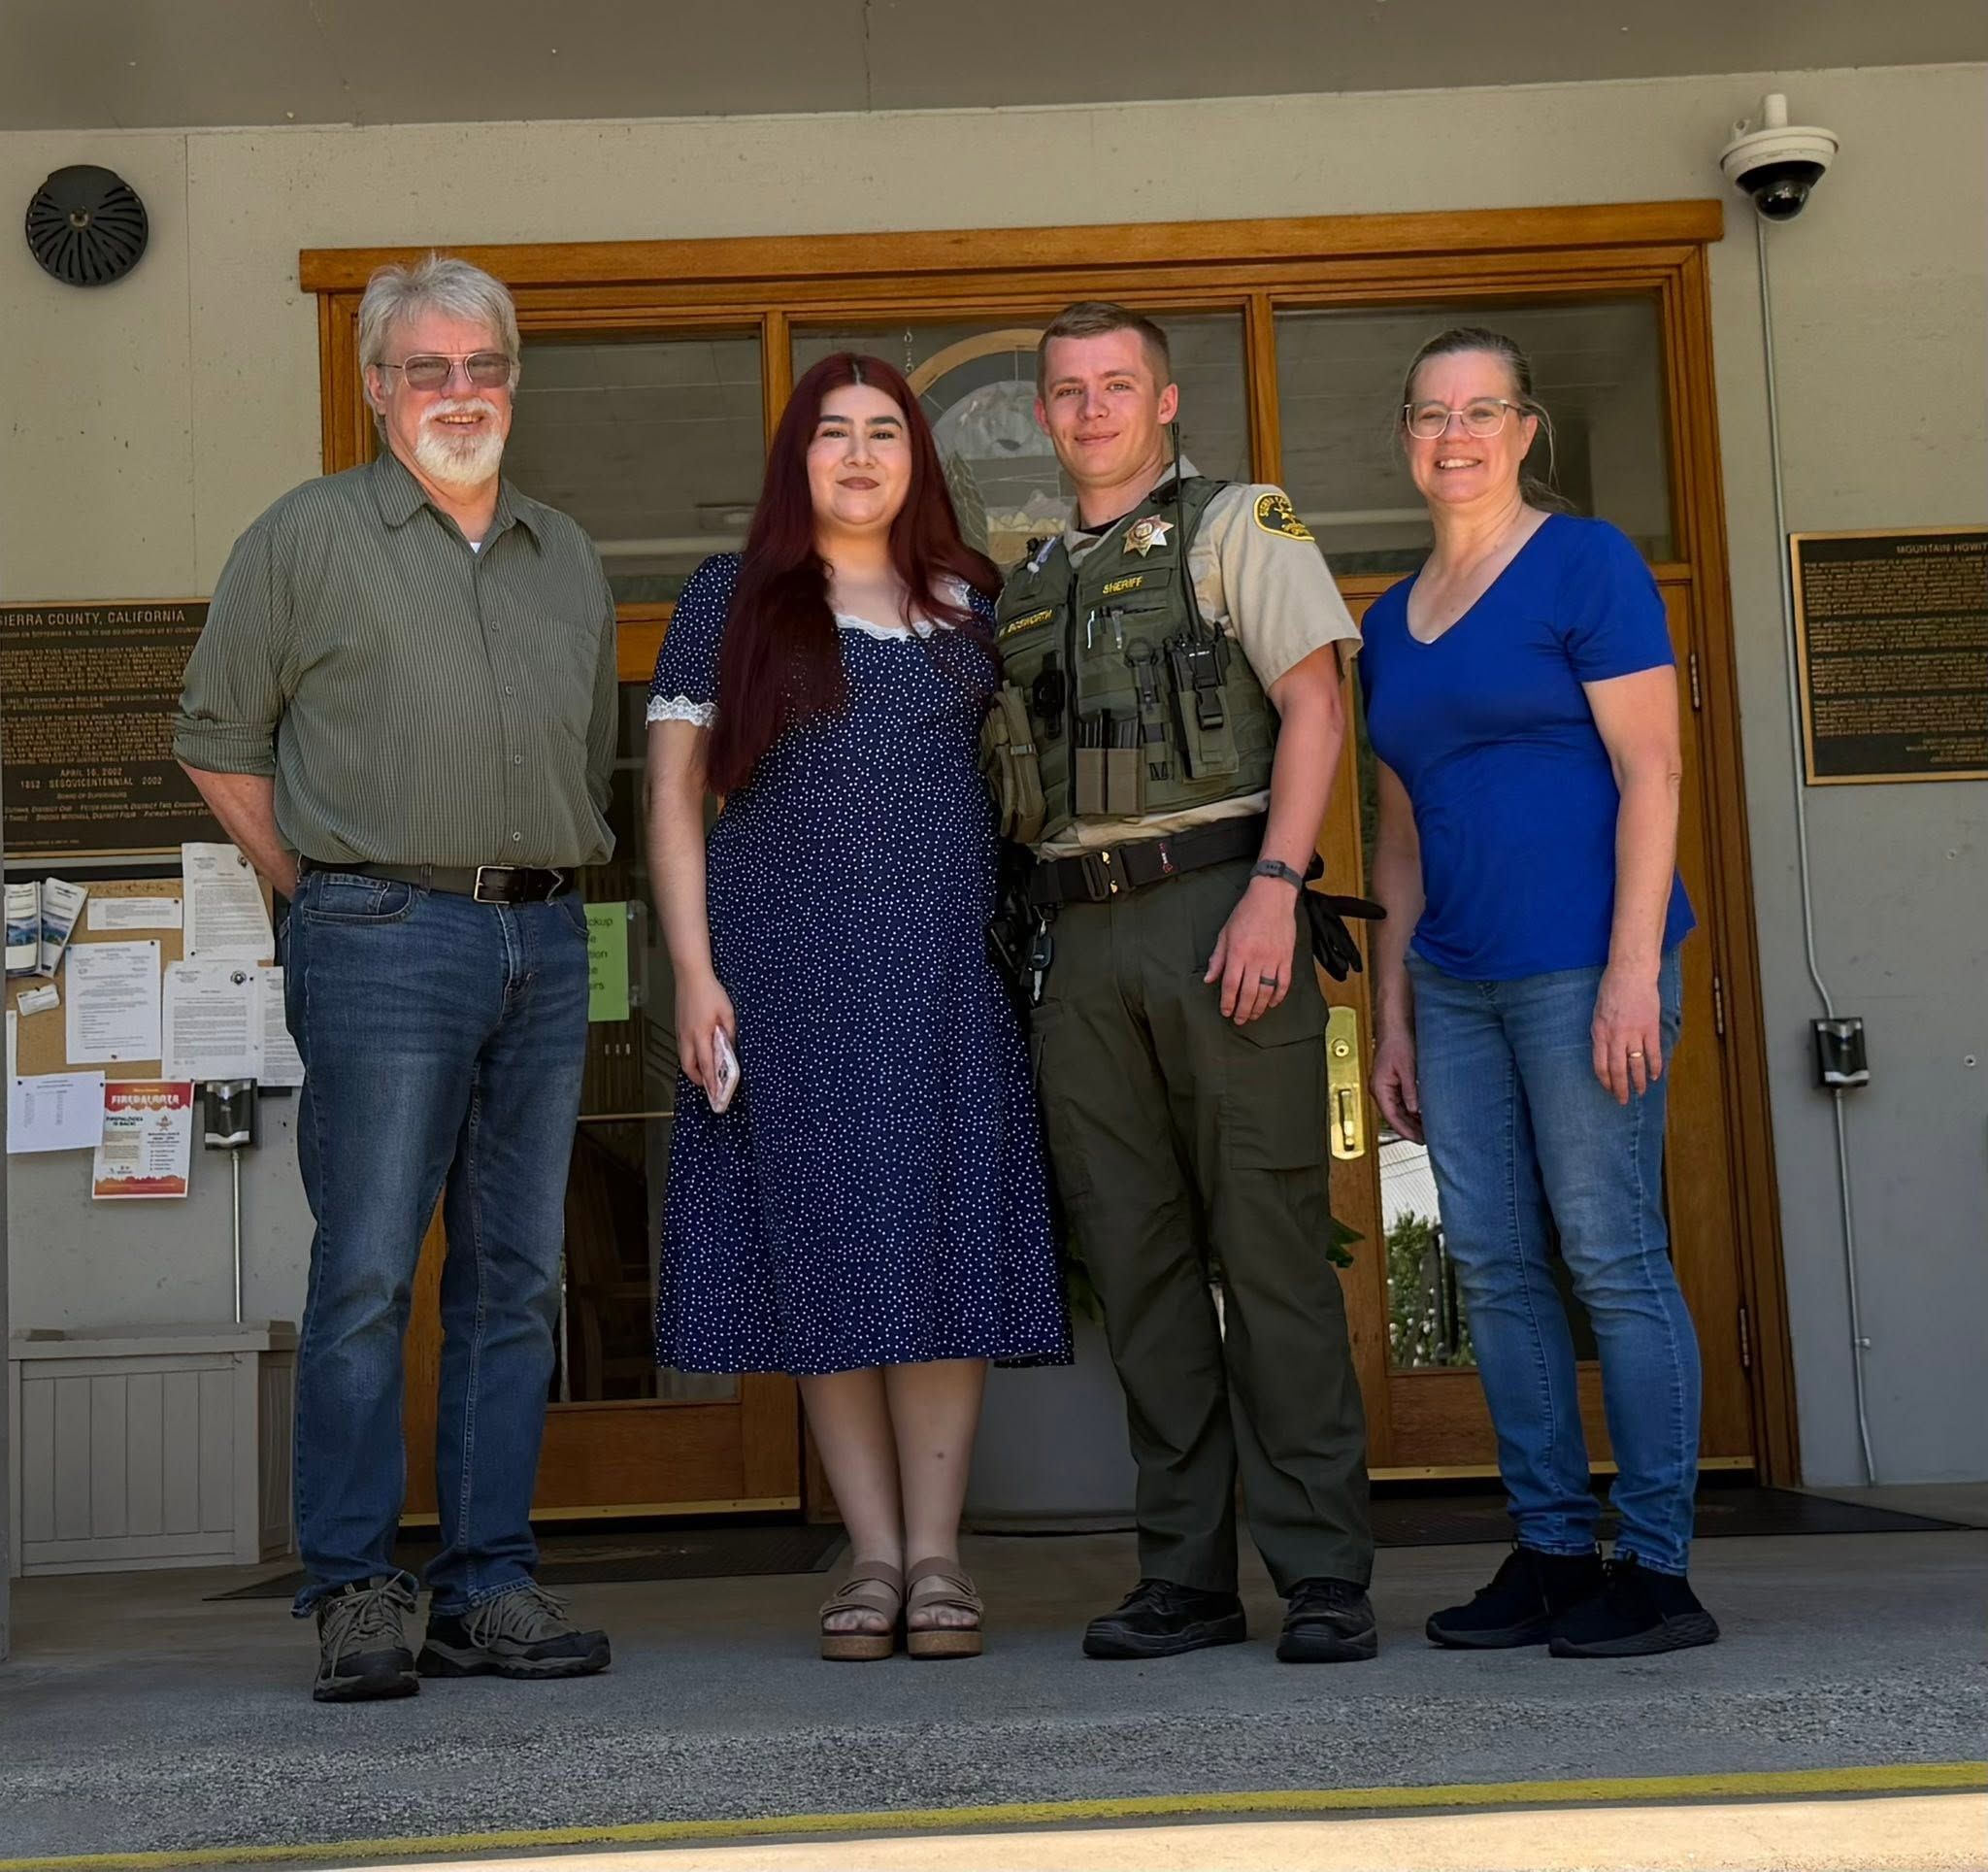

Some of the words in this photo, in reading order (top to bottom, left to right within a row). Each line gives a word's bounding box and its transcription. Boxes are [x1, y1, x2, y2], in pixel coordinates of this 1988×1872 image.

[1102, 576, 1143, 594] SHERIFF
[49, 612, 102, 626] COUNTY,
[108, 610, 185, 623] CALIFORNIA
[102, 767, 122, 776] 2002
[142, 776, 163, 786] 2002
